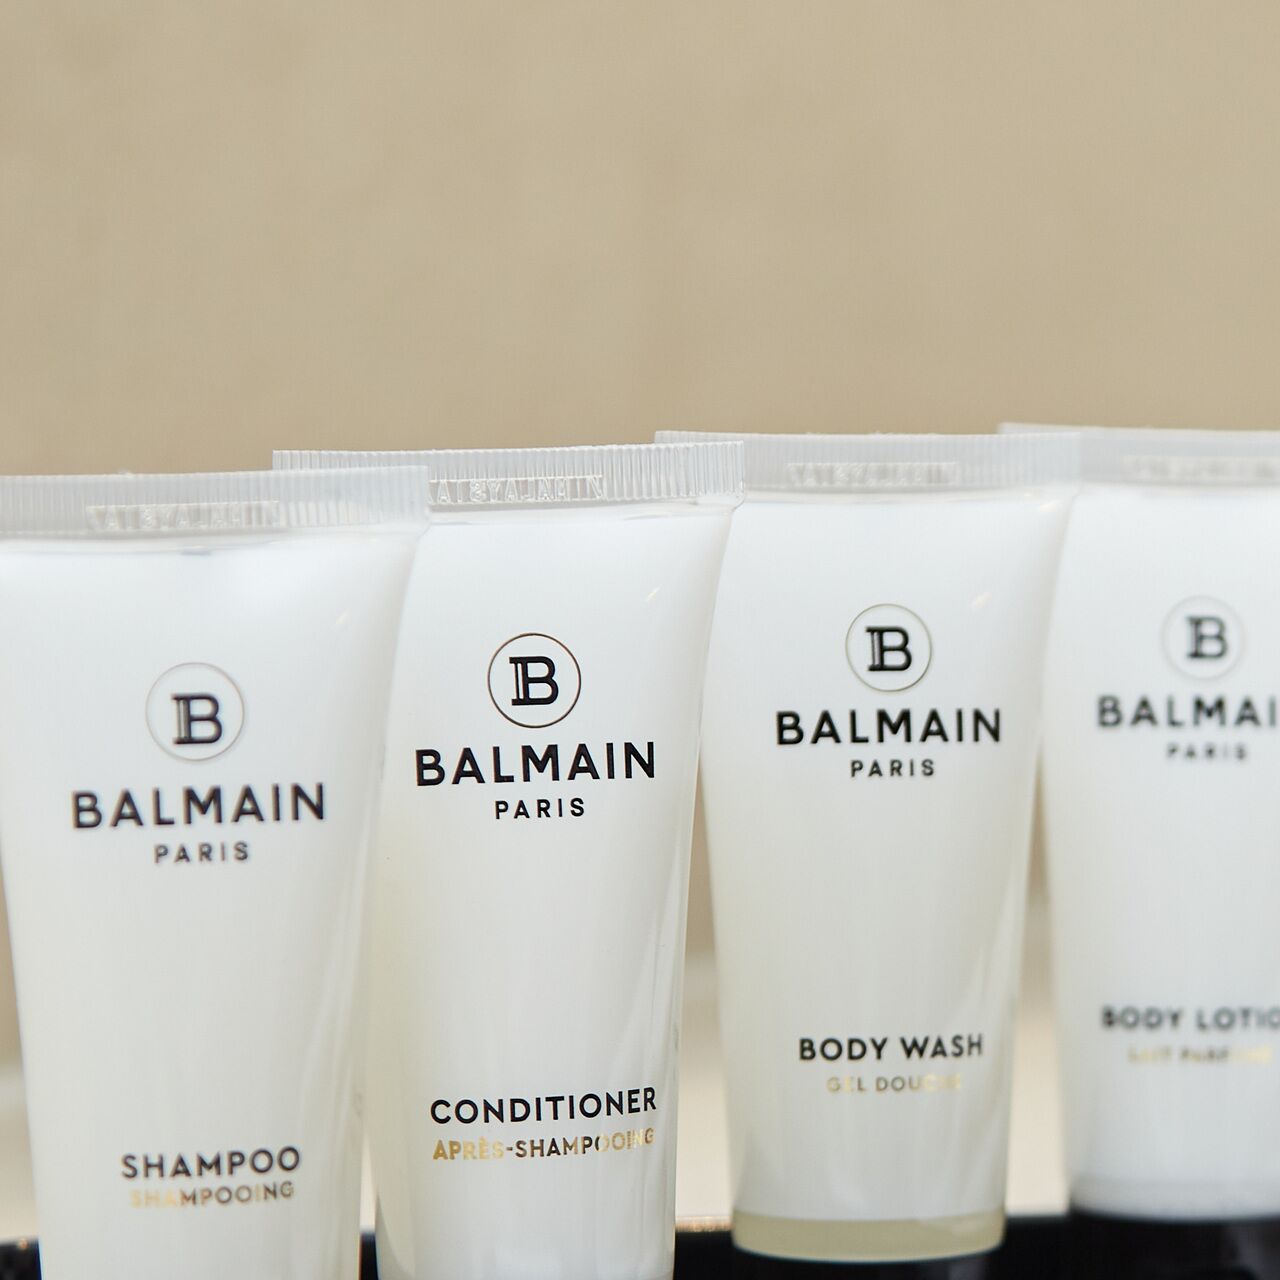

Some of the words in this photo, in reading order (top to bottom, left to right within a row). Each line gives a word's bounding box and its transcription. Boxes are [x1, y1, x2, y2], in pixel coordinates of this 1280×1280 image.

[866, 626, 912, 672] B
[1186, 616, 1228, 660] B
[508, 655, 559, 706] B
[171, 693, 223, 745] B
[776, 708, 1002, 746] BALMAIN
[415, 741, 656, 786] BALMAIN
[850, 759, 935, 778] PARIS
[1166, 743, 1247, 762] PARIS
[71, 782, 326, 830] BALMAIN
[495, 797, 586, 820] PARIS
[154, 841, 249, 864] PARIS
[1101, 1004, 1182, 1030] BODY
[800, 1037, 888, 1061] BODY
[899, 1033, 984, 1059] WASH
[430, 1086, 657, 1124] CONDITIONER
[121, 1145, 301, 1179] SHAMPOO
[130, 1181, 295, 1208] SHAMPOOING
